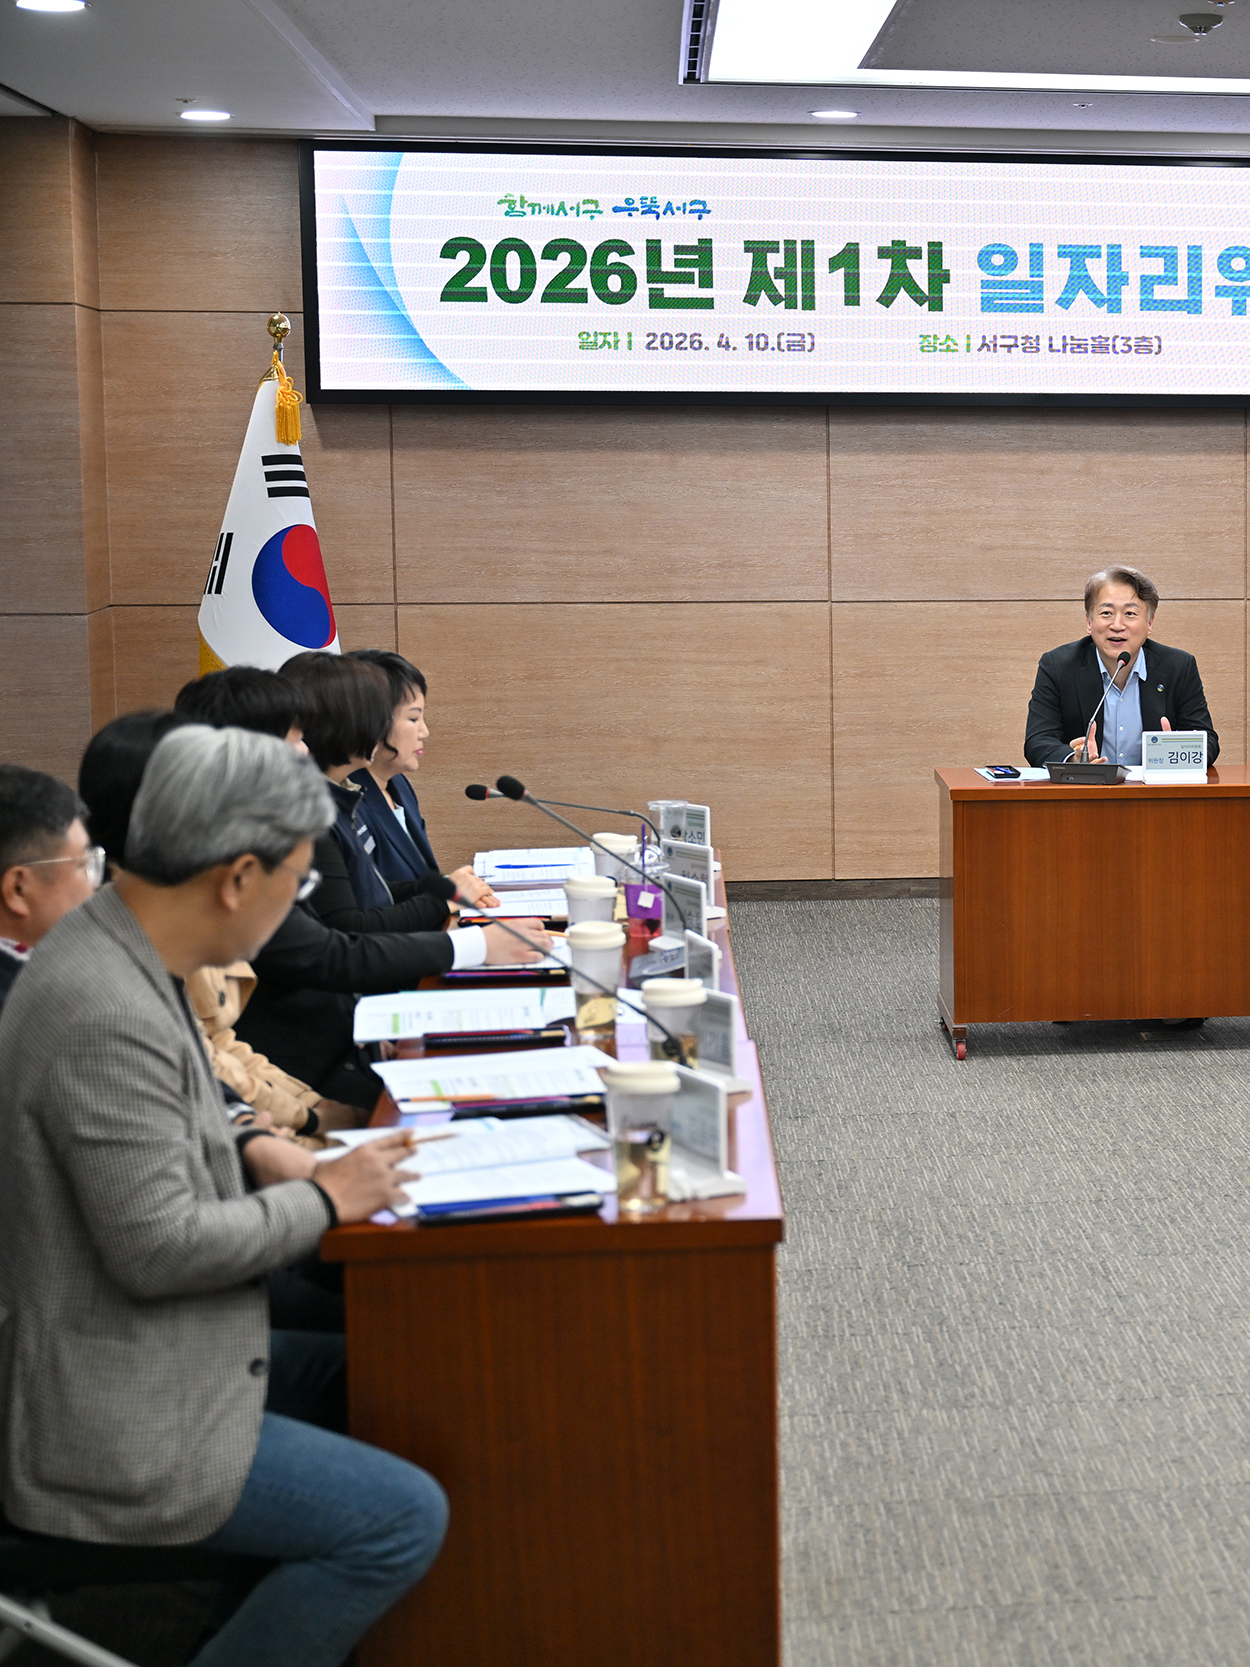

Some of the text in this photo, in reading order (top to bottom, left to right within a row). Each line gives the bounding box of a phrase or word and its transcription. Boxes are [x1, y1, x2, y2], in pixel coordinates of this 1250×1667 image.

[496, 193, 712, 220] 함께서구 우뚝서구
[439, 236, 715, 311] 2026년
[742, 239, 951, 313] 제1차
[577, 330, 621, 351] 일자
[645, 332, 710, 351] 2026.
[716, 332, 738, 351] 4.
[744, 332, 816, 353] 10.(금)
[918, 334, 959, 353] 장소
[976, 334, 1041, 354] 서구청
[1048, 335, 1162, 355] 나눔홀(3층)
[1168, 751, 1203, 764] 김이강
